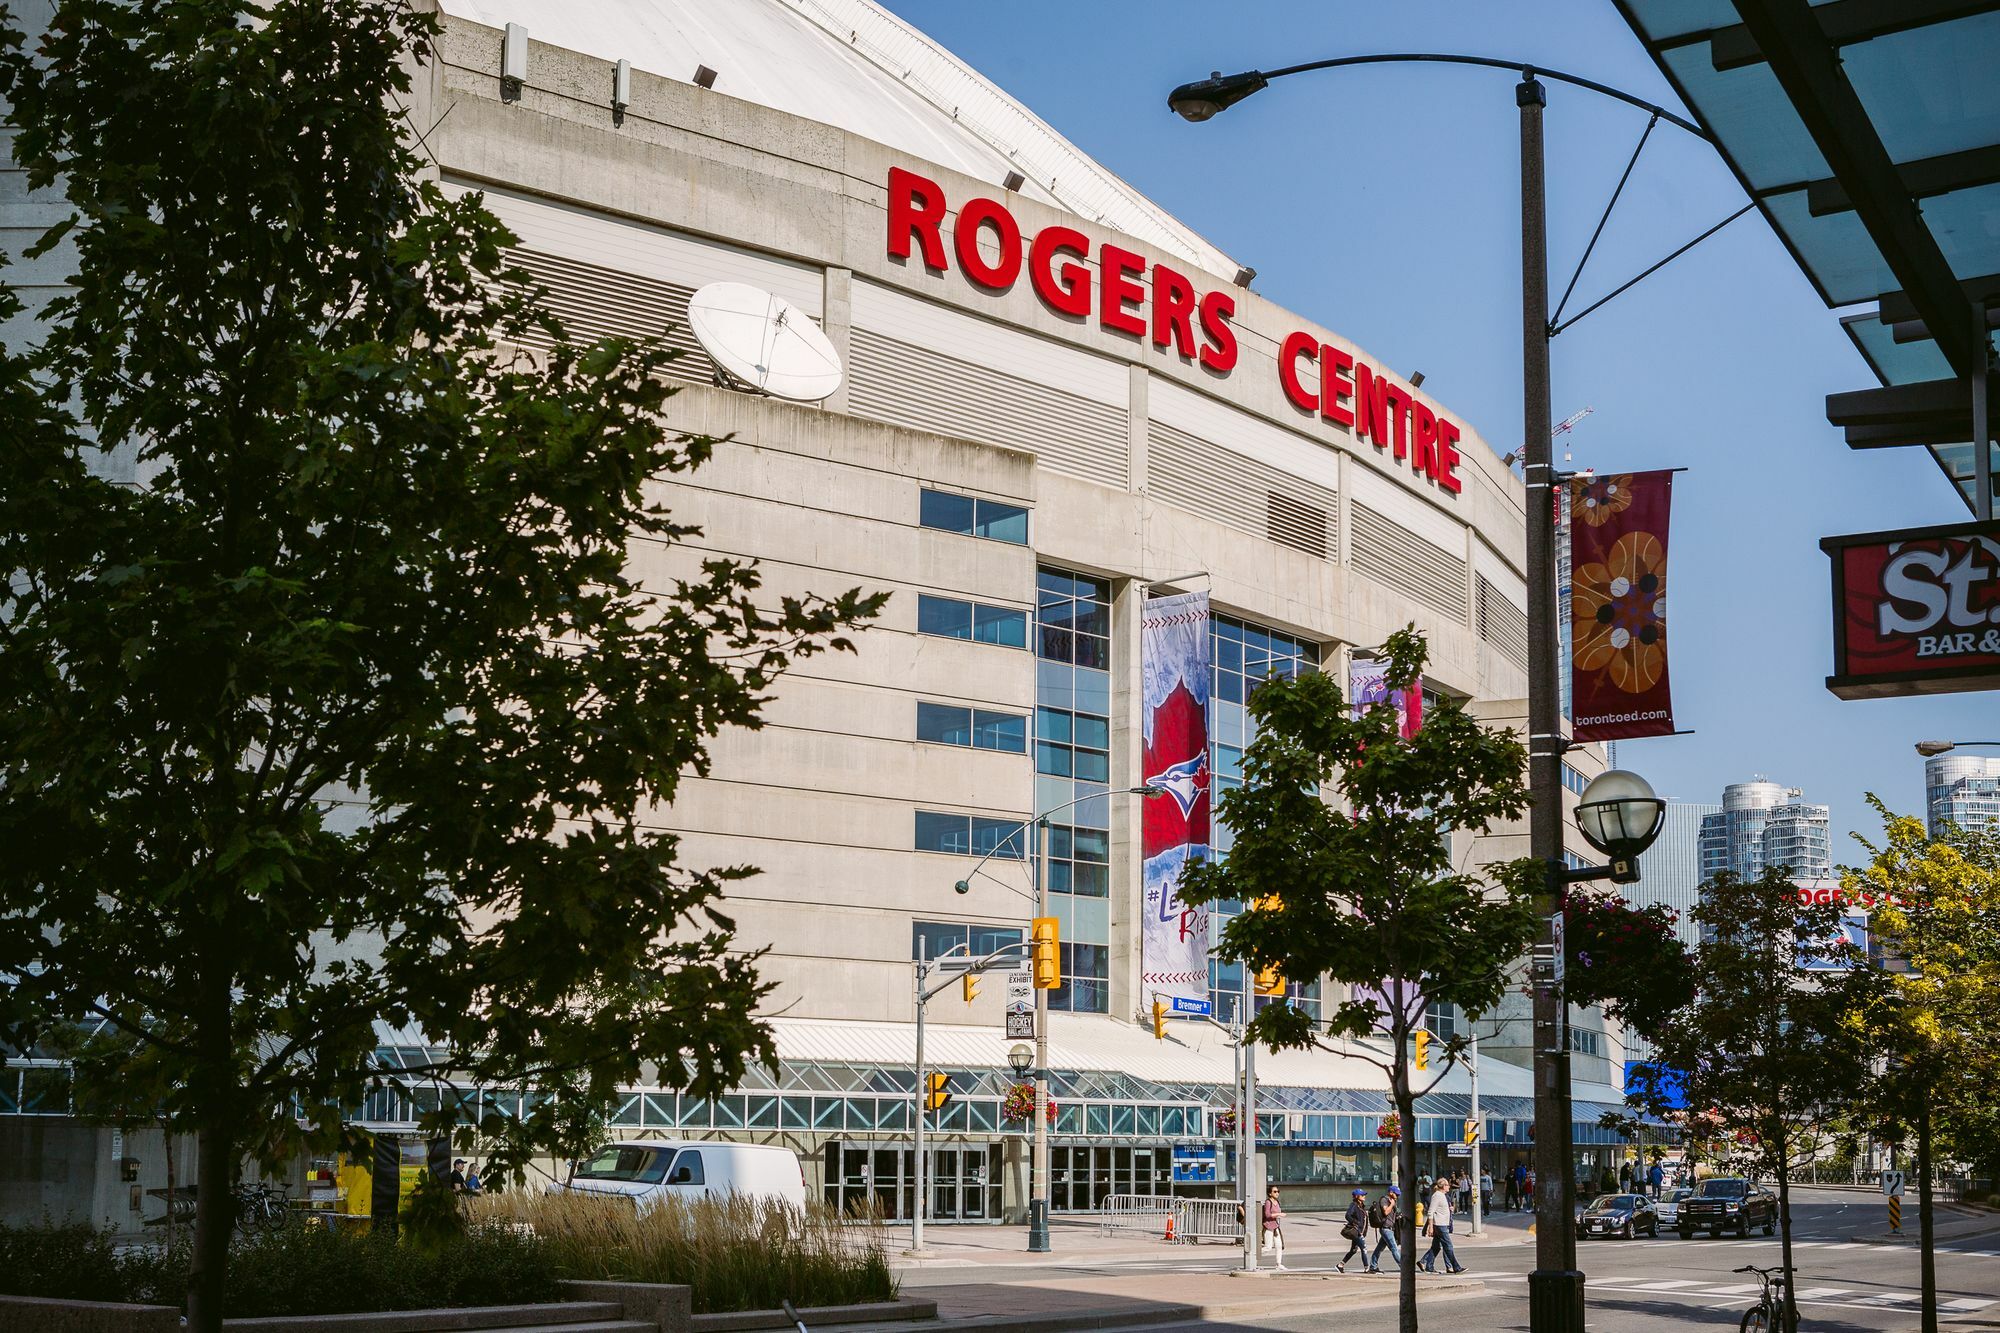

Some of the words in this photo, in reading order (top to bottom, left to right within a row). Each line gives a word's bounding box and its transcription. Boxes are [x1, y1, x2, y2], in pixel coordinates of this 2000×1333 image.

[887, 166, 1239, 374] ROGERS
[1278, 330, 1462, 495] CENTRE
[1917, 632, 1976, 657] BAR
[1978, 628, 2000, 654] &
[1576, 710, 1667, 726] torontoed.com
[1178, 998, 1203, 1012] Bremner
[1008, 1015, 1032, 1028] HOCKEY
[1184, 1145, 1205, 1153] TICKETS
